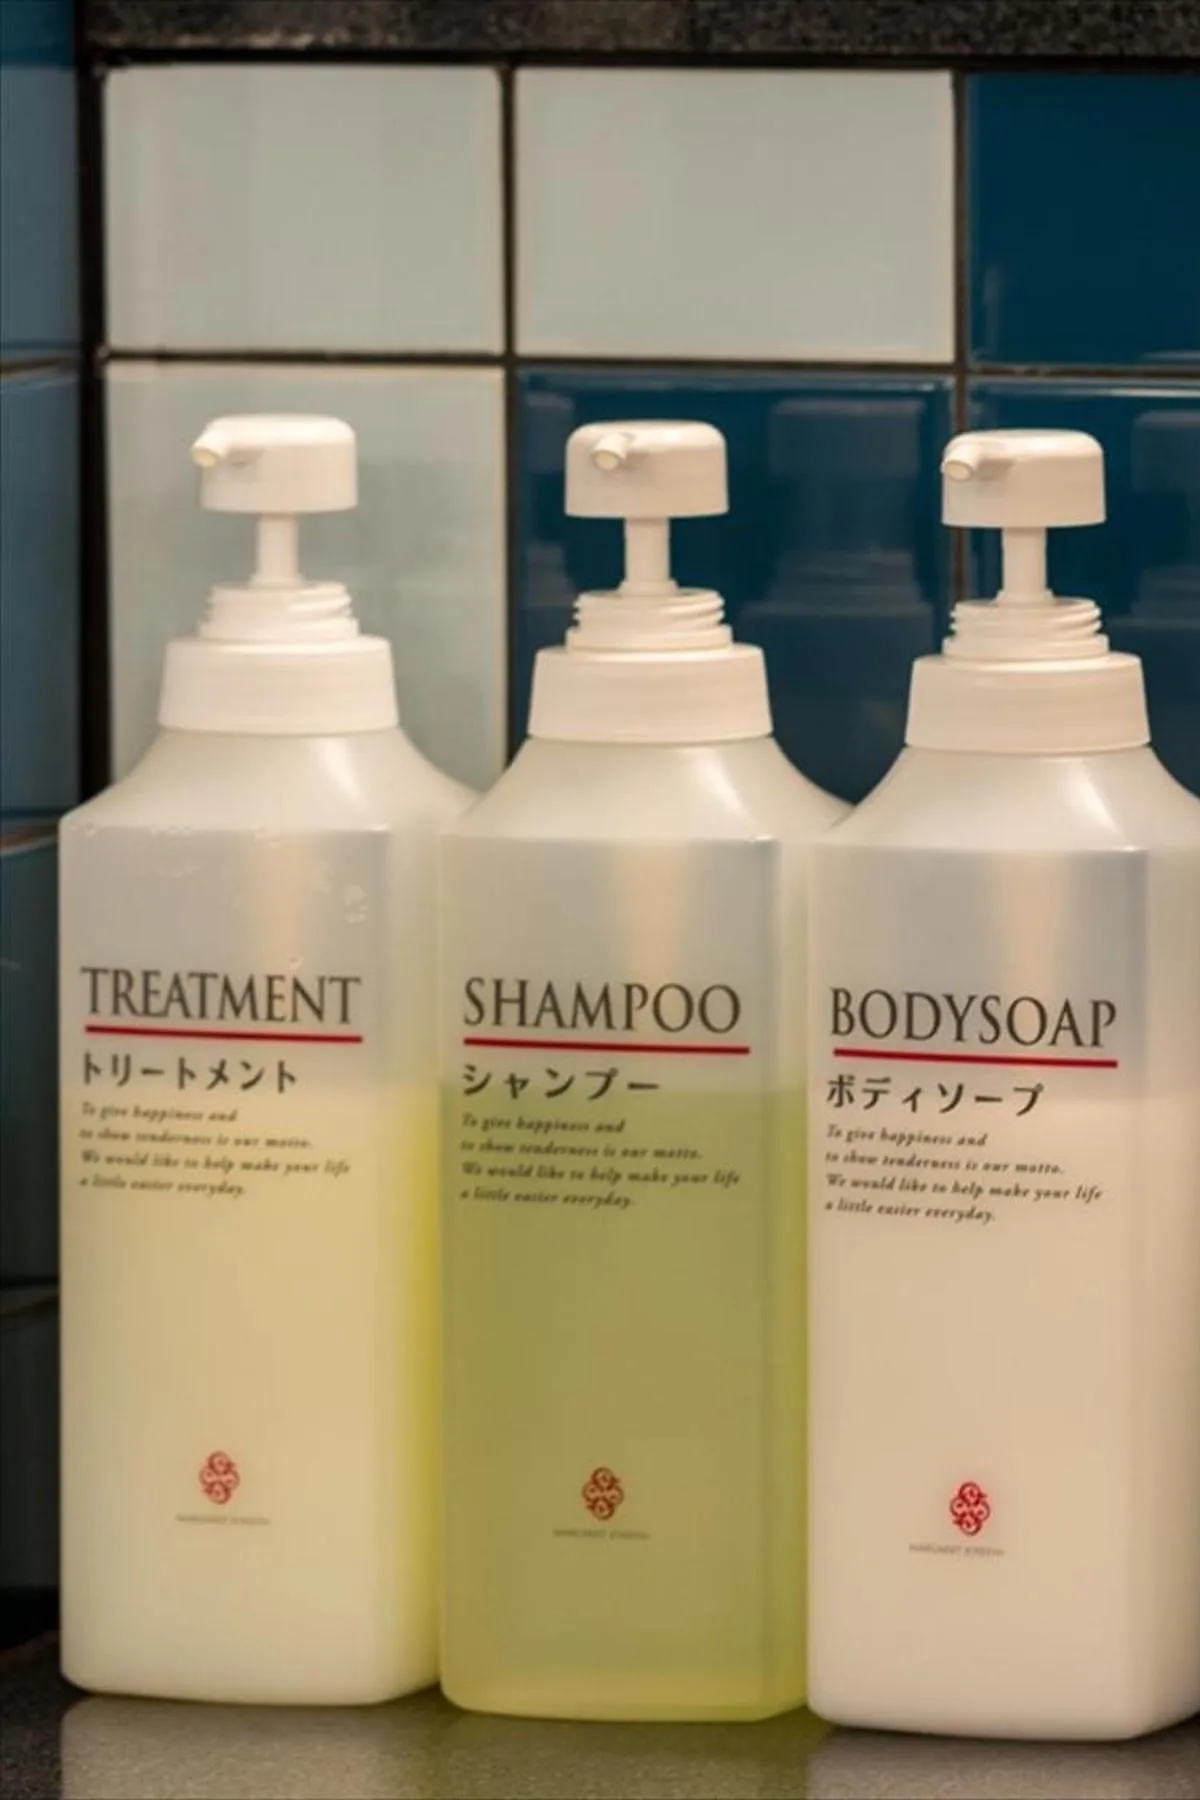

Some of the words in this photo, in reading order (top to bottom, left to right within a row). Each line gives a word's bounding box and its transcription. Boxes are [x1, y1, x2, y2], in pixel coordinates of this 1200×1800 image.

[80, 967, 362, 1024] TREATMENT
[464, 977, 740, 1034] SHAMPOO
[830, 987, 1117, 1047] BODYSOAP
[84, 1051, 297, 1094] トリートメント
[462, 1063, 660, 1101] シャンプー
[827, 1074, 1045, 1116] ボディソープ
[82, 1103, 96, 1117] To
[99, 1105, 128, 1121] give
[132, 1106, 203, 1123] happiness
[208, 1110, 238, 1122] and
[462, 1114, 478, 1127] To
[481, 1117, 511, 1132] give
[516, 1116, 590, 1134] happiness
[595, 1120, 626, 1133] and
[79, 1128, 94, 1140] to
[97, 1130, 130, 1142] show
[135, 1131, 212, 1146] tenderness
[216, 1135, 230, 1146] is
[234, 1137, 260, 1147] our
[265, 1137, 312, 1149] motto.
[827, 1125, 842, 1138] To
[846, 1128, 875, 1143] give
[880, 1128, 952, 1147] happiness
[957, 1134, 988, 1147] and
[461, 1140, 475, 1151] to
[478, 1141, 515, 1153] show
[519, 1142, 598, 1158] tenderness
[604, 1146, 617, 1158] is
[620, 1149, 649, 1158] our
[653, 1148, 702, 1160] motto.
[82, 1151, 101, 1165] We
[105, 1153, 148, 1167] would
[152, 1155, 179, 1168] like
[184, 1158, 199, 1169] to
[204, 1158, 236, 1174] help
[241, 1160, 279, 1172] make
[283, 1162, 319, 1176] your
[324, 1162, 351, 1177] life
[826, 1152, 839, 1162] to
[843, 1152, 879, 1165] show
[883, 1154, 960, 1170] tenderness
[965, 1159, 978, 1171] is
[982, 1162, 1010, 1172] our
[1015, 1161, 1064, 1174] motto.
[79, 1177, 88, 1187] a
[92, 1176, 127, 1190] little
[130, 1179, 173, 1191] easier
[177, 1181, 244, 1198] everyday.
[462, 1163, 483, 1176] We
[487, 1165, 533, 1178] would
[537, 1166, 564, 1180] like
[570, 1169, 585, 1180] to
[590, 1168, 622, 1186] help
[627, 1170, 667, 1183] make
[671, 1173, 708, 1186] your
[714, 1172, 741, 1188] life
[461, 1190, 469, 1199] a
[473, 1187, 509, 1201] little
[514, 1191, 558, 1203] easier
[562, 1192, 634, 1209] everyday.
[826, 1174, 847, 1187] We
[851, 1177, 895, 1191] would
[899, 1179, 926, 1193] like
[932, 1183, 947, 1193] to
[951, 1182, 983, 1198] help
[989, 1184, 1029, 1198] make
[1034, 1188, 1069, 1201] your
[1076, 1186, 1103, 1204] life
[825, 1201, 833, 1211] a
[837, 1200, 873, 1213] little
[878, 1205, 920, 1217] easier
[925, 1206, 994, 1224] everyday.
